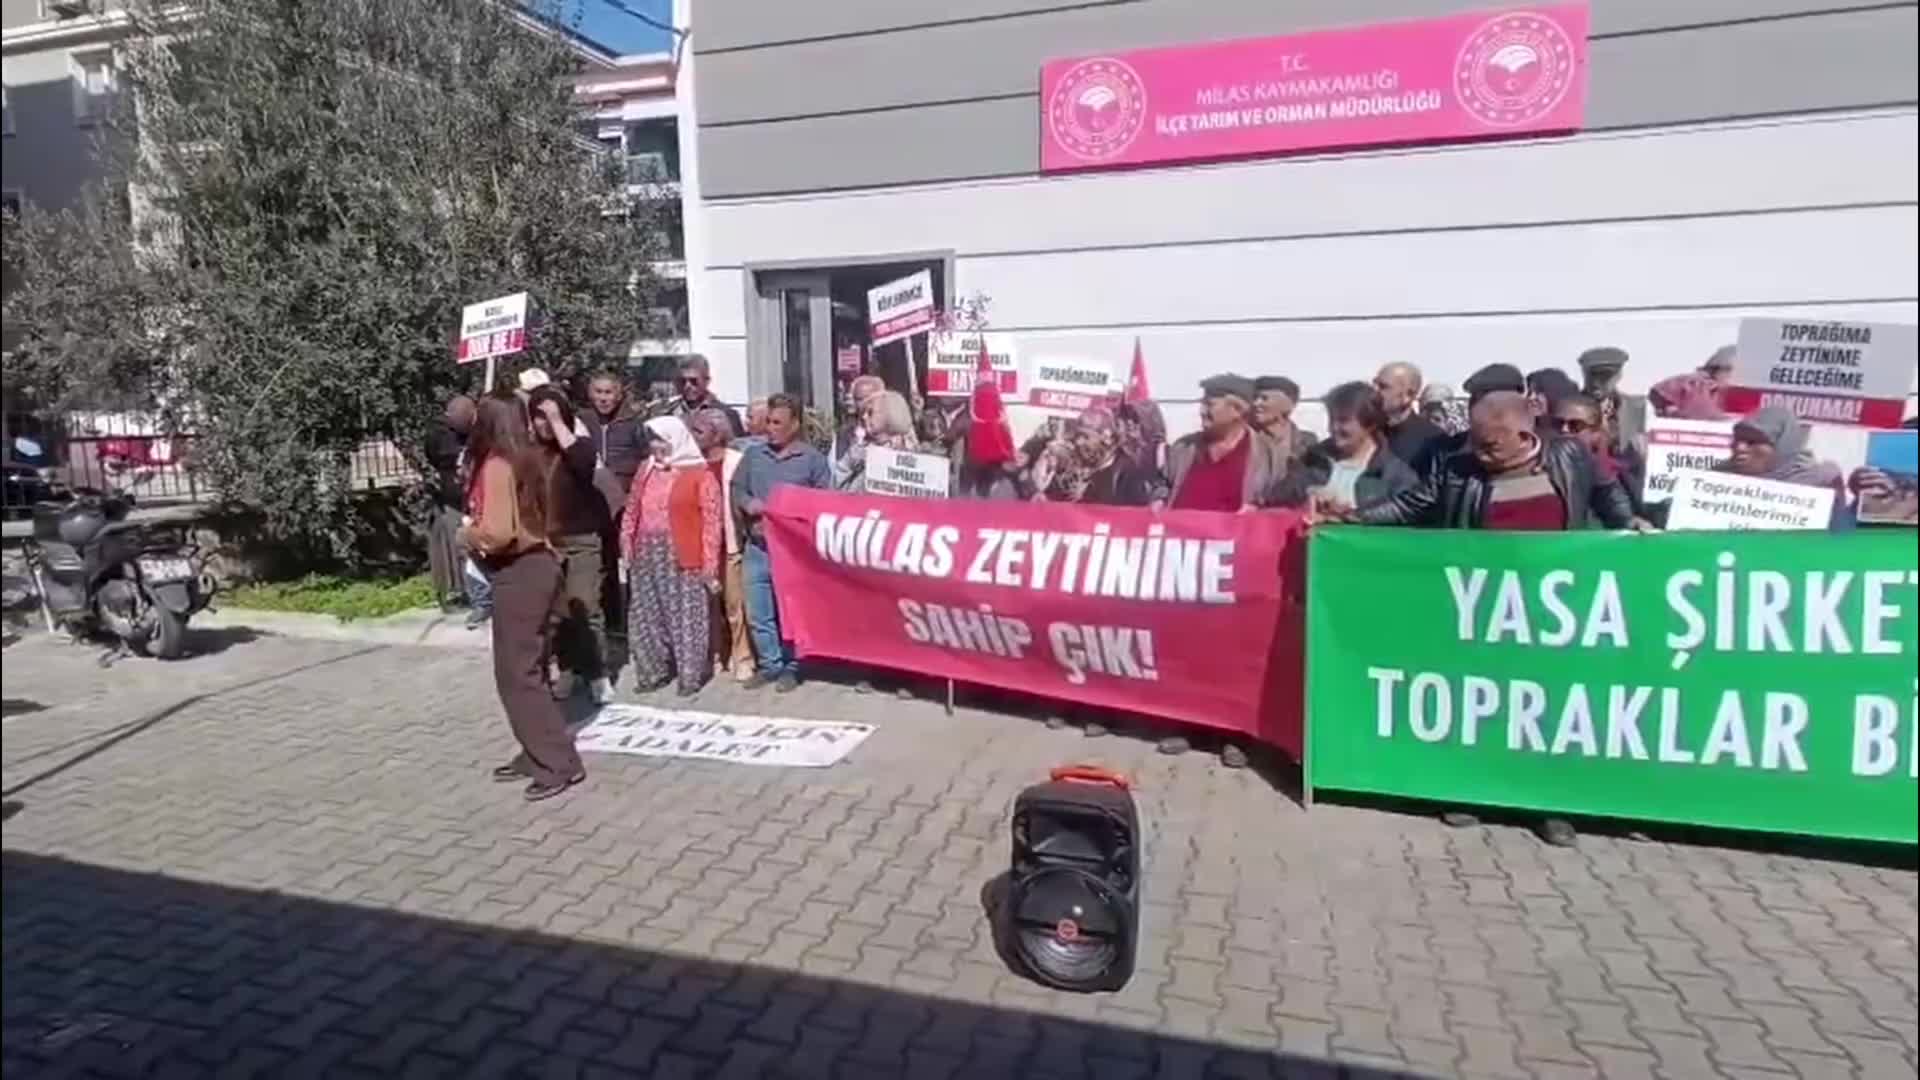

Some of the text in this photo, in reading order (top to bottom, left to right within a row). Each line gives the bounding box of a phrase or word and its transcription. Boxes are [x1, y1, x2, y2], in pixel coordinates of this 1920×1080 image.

[1280, 54, 1309, 73] T.C.
[1196, 67, 1398, 105] MİLAS KAYMAKAMLIĞI
[1189, 108, 1239, 130] TARIM
[1242, 106, 1263, 126] VE
[1264, 103, 1327, 124] ORMAN
[1330, 87, 1442, 118] MÜDÜRLÜĞÜ
[1781, 322, 1872, 344] TOPRAĞIMA
[1780, 345, 1862, 367] ZEYTİNİME
[1769, 367, 1864, 390] GELECEĞİME
[1666, 452, 1724, 473] Şirketle
[815, 508, 1237, 604] MİLAS ZEYTİNİNE
[1445, 551, 1918, 670] YASA ŞİRKE
[899, 598, 1159, 684] SAHİP ÇIK!
[1368, 666, 1809, 772] TOPRAKLAR
[618, 735, 781, 757] ADALET
